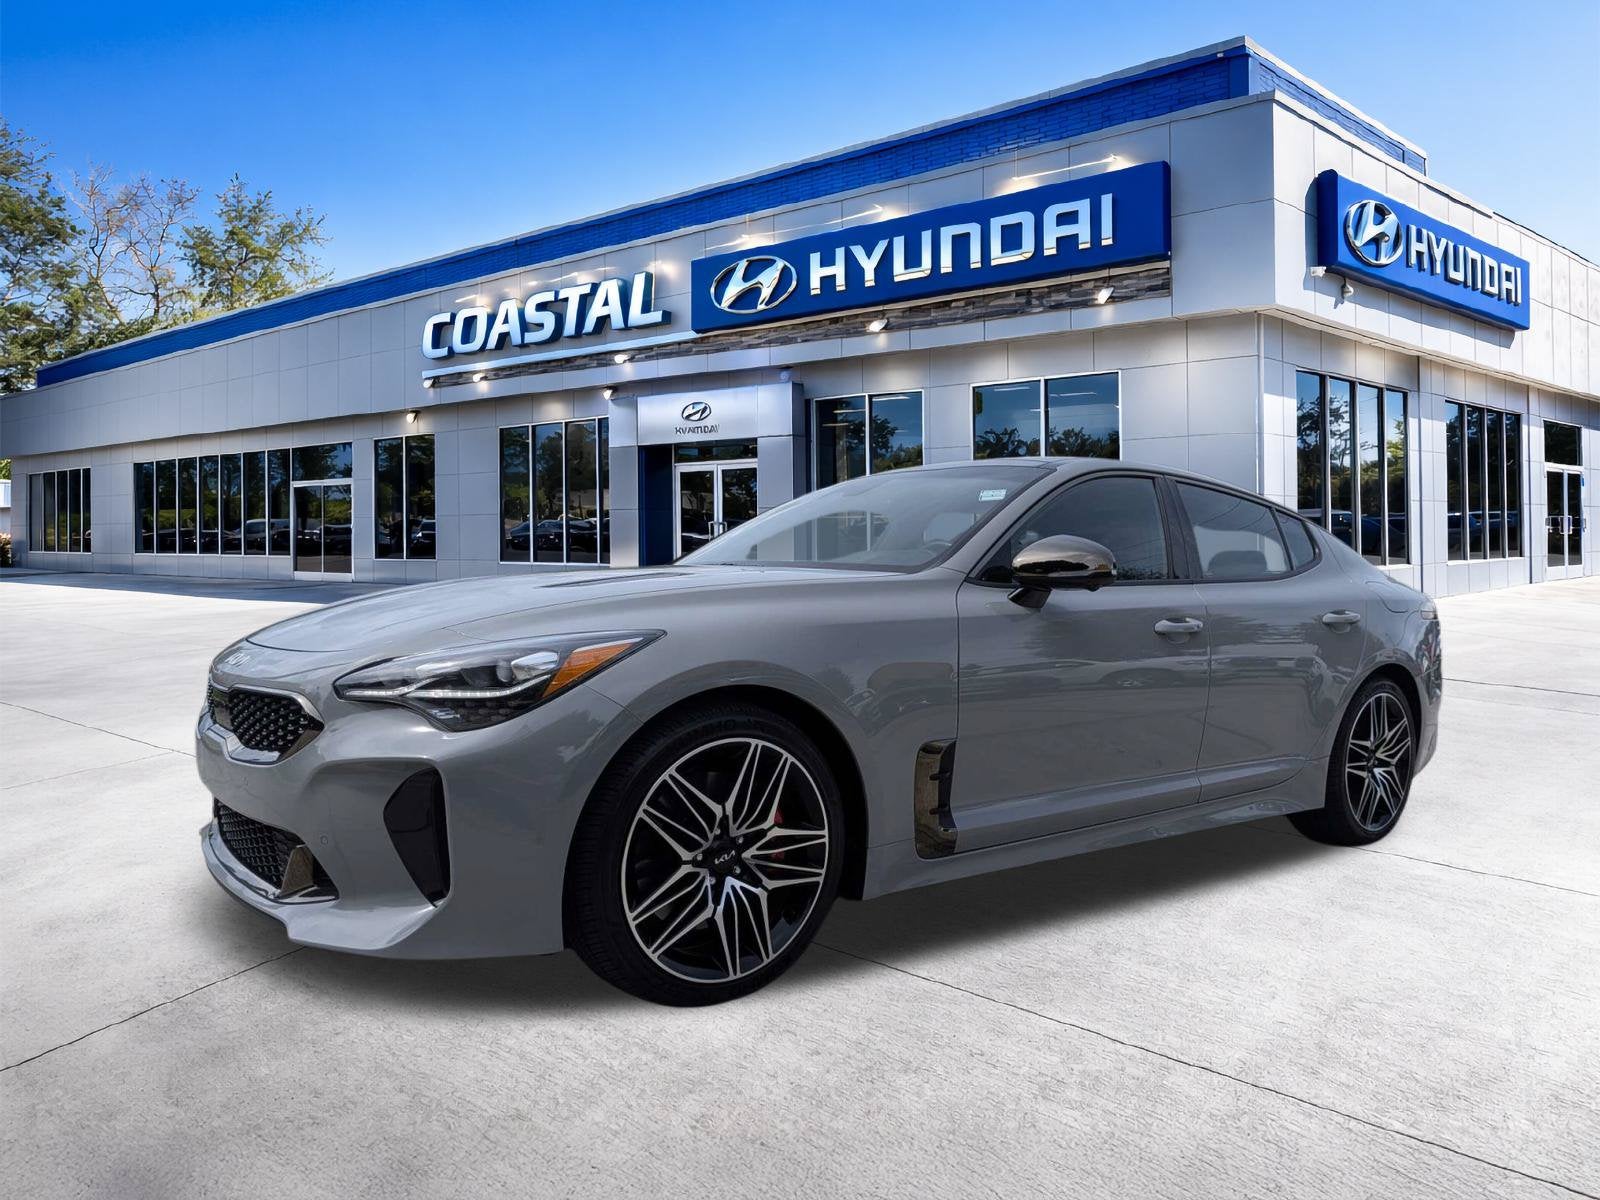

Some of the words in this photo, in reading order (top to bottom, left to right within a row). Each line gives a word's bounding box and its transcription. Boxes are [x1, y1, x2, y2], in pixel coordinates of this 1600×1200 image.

[809, 192, 1113, 295] HYUNDAI
[1407, 224, 1522, 306] HYUNDAI
[422, 271, 669, 360] COASTAL
